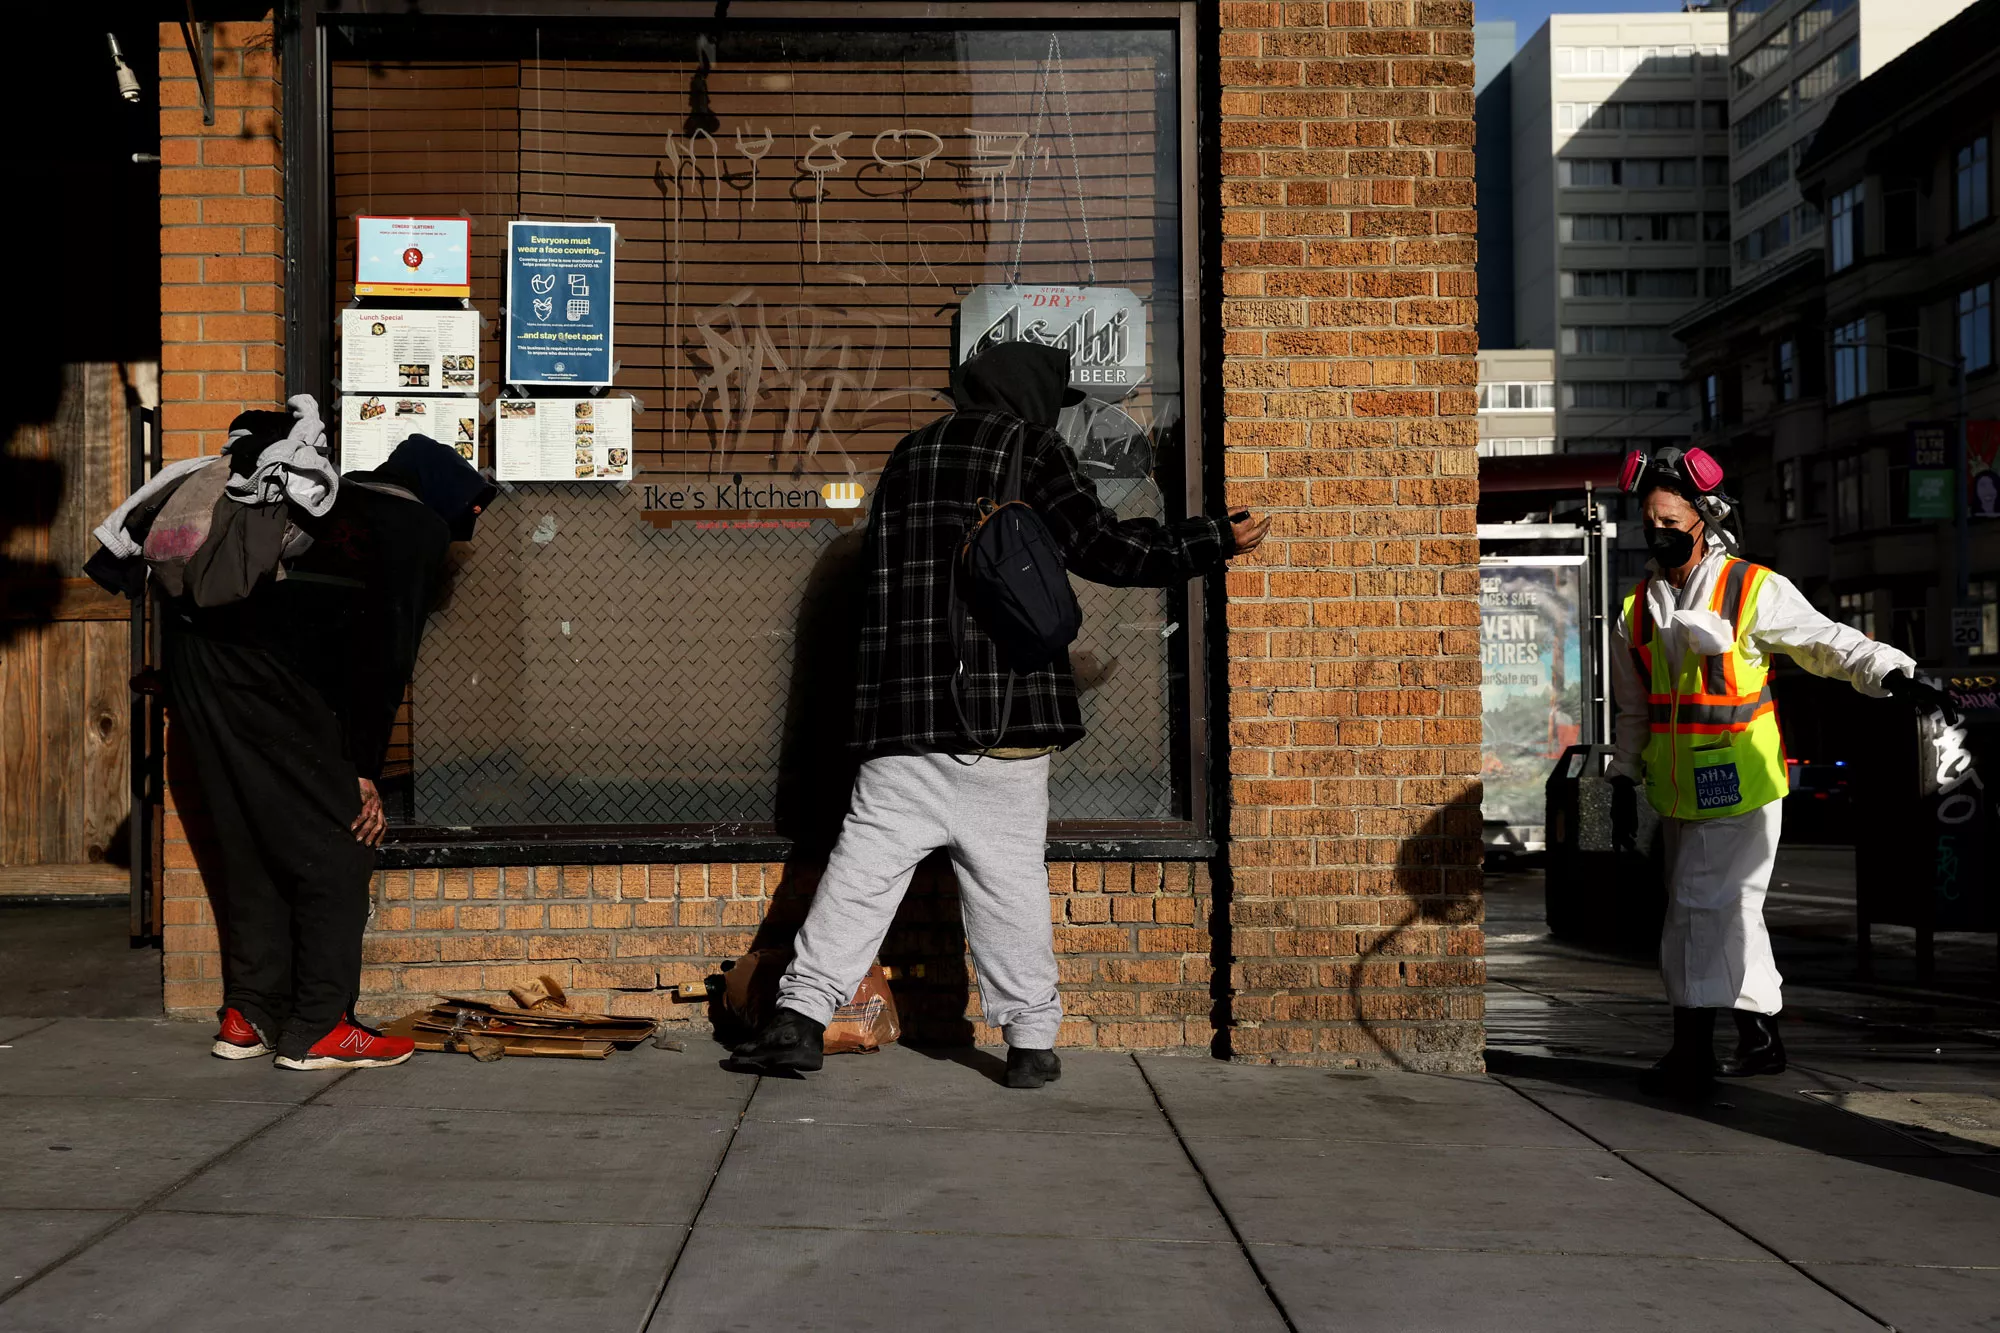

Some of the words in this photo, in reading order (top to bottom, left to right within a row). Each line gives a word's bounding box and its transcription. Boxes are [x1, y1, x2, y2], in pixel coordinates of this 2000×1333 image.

[531, 236, 569, 245] Everyone
[545, 246, 563, 254] face
[540, 332, 556, 340] stay
[1080, 369, 1127, 383] BEER
[644, 485, 705, 510] Ike's
[717, 473, 818, 510] Kitchen
[1479, 592, 1508, 606] ACES
[1512, 592, 1536, 605] SAFE
[1480, 616, 1538, 640] VENT
[1955, 628, 1979, 642] 20
[1482, 673, 1538, 686] orSafe.org
[1698, 784, 1738, 797] PUBLIC
[1700, 794, 1739, 806] WORKS
